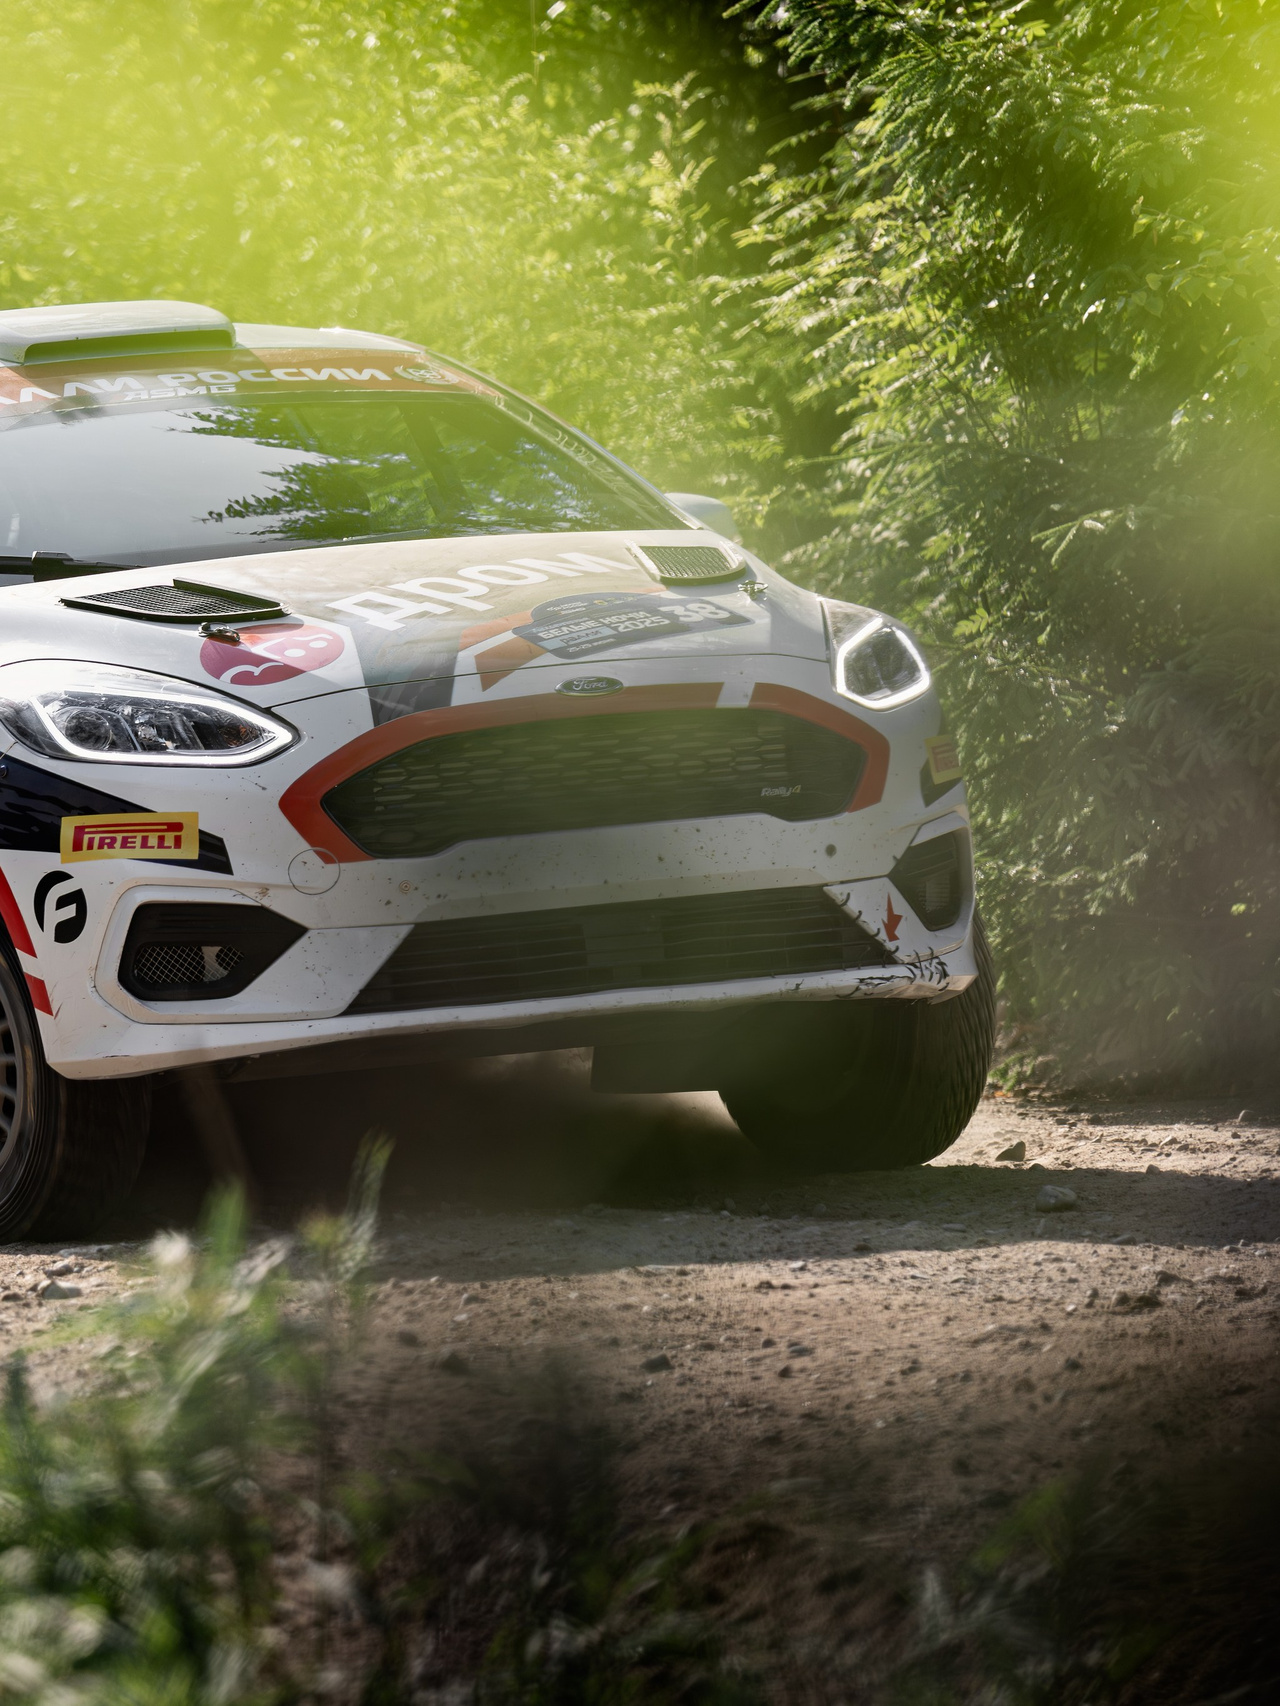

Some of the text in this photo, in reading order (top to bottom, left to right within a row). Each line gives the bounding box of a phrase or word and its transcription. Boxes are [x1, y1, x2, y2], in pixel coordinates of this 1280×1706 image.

[157, 367, 392, 388] РОССИИ
[657, 603, 731, 622] 38
[537, 620, 603, 639] БЕЛЫЕ
[599, 611, 652, 625] НОЧИ
[610, 616, 671, 632] 2025
[573, 677, 608, 691] Ford
[72, 822, 184, 852] PIRELLI
